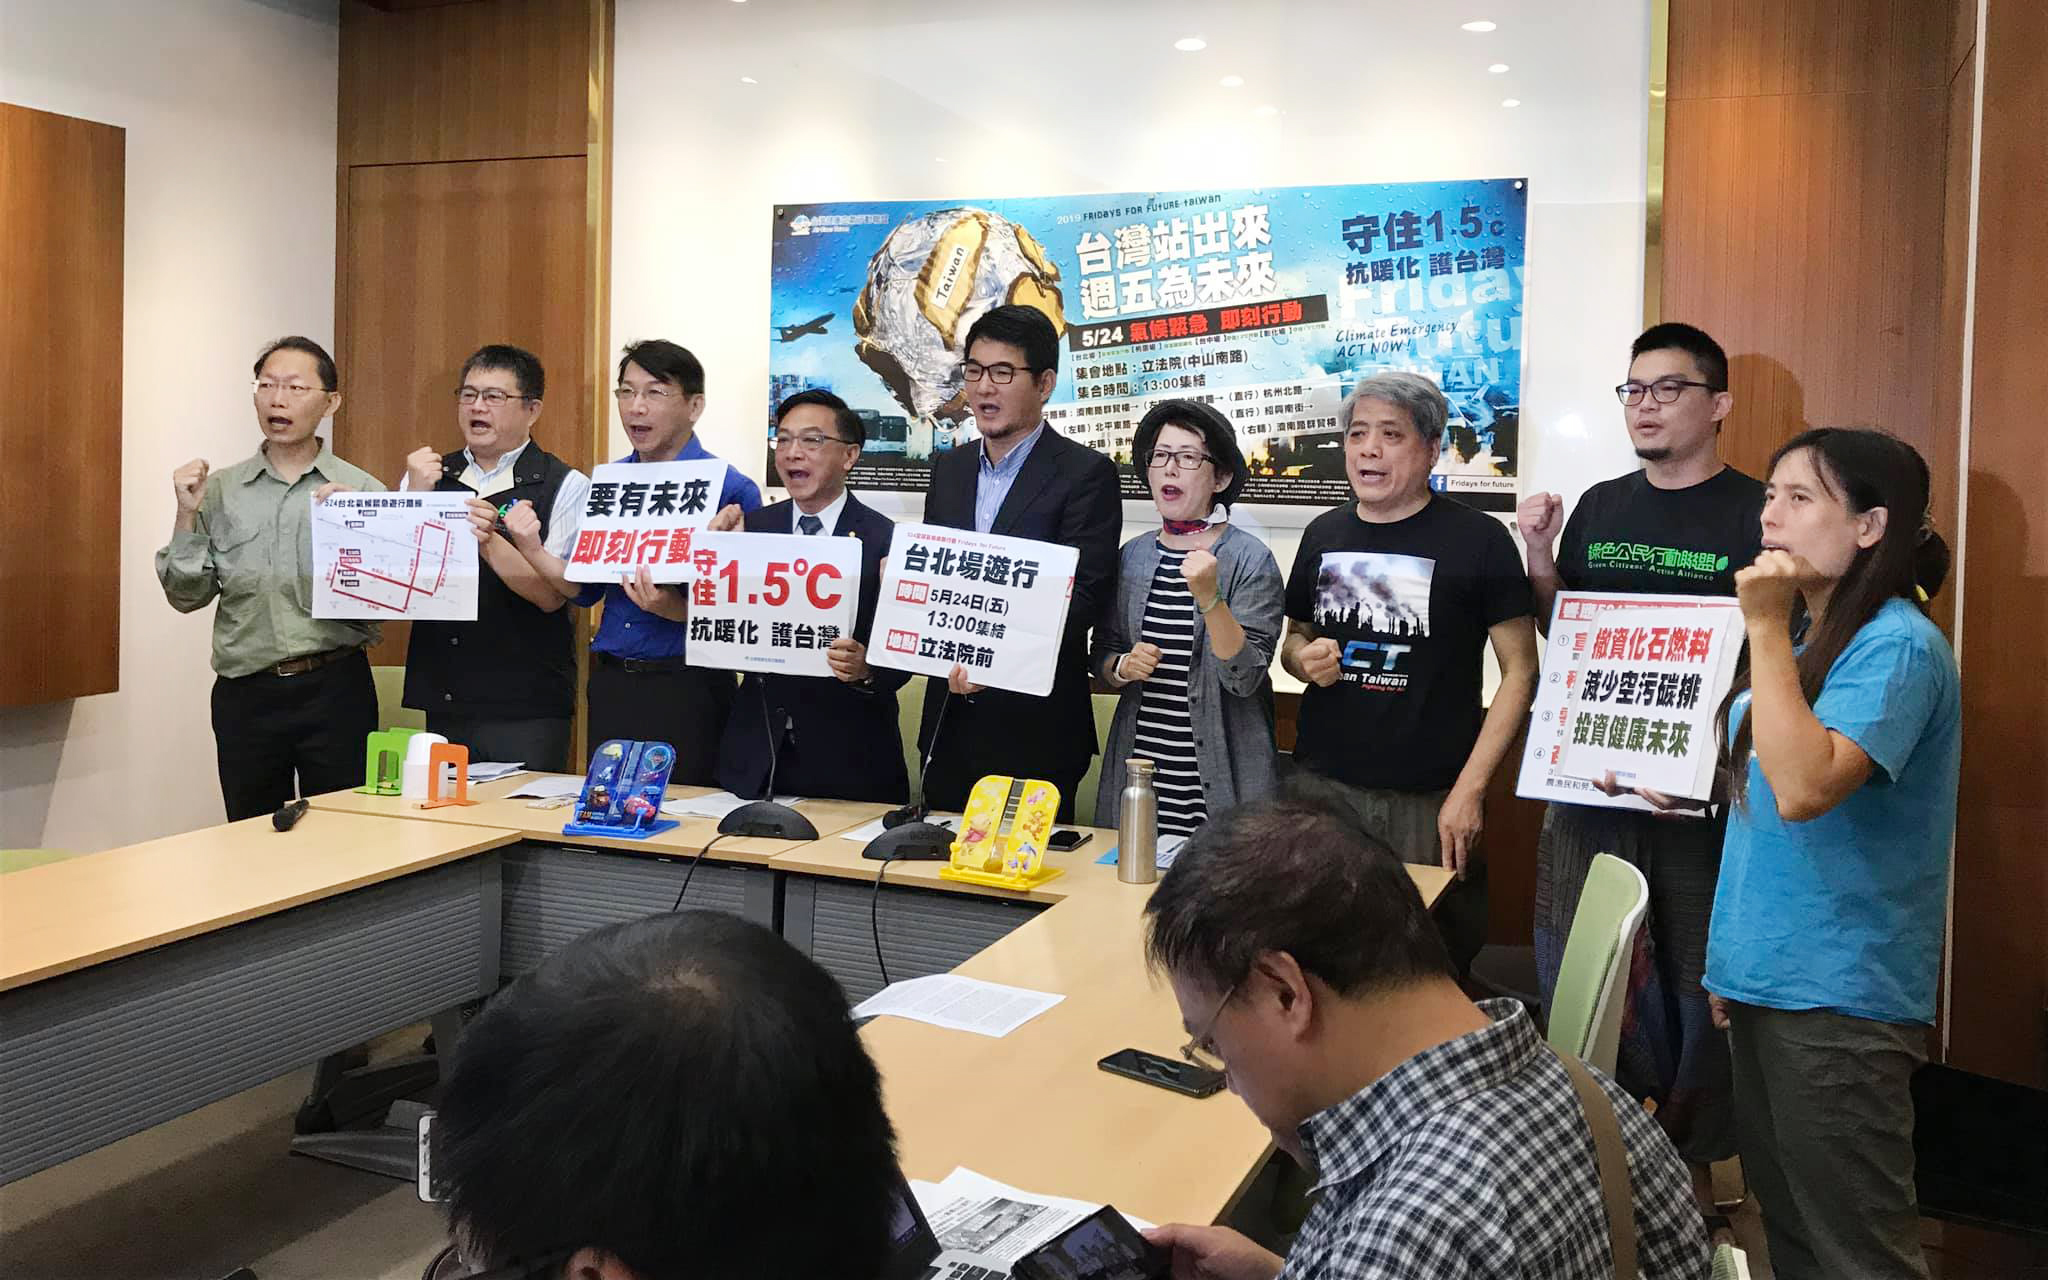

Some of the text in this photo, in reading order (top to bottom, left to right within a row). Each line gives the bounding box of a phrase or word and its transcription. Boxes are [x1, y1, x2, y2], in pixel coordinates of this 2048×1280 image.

[1125, 205, 1143, 216] FOR
[1075, 203, 1272, 276] 台灣站出來
[936, 246, 965, 300] Taiwan
[1345, 245, 1505, 285] 抗暖化 護台灣
[1080, 251, 1277, 321] 週五為未來
[1081, 300, 1303, 347] 5/24 氣候緊急 即刻行動
[1335, 327, 1386, 343] Climate
[1390, 320, 1458, 338] Emergency
[1336, 343, 1366, 358] ACT
[586, 478, 711, 517] 要有未來
[1451, 479, 1478, 488] Fridays
[571, 527, 696, 565] 即刻行動
[692, 548, 718, 606] 守住
[903, 543, 1040, 589] 台北場遊行
[690, 615, 841, 650] 抗暖化 護台灣
[1591, 626, 1713, 664] 撤資化石燃料
[918, 637, 995, 668] 立法院前
[1361, 673, 1408, 687] Taiwan
[1581, 669, 1703, 710] 減少空污碳排
[1572, 711, 1693, 758] 投資健康未來
